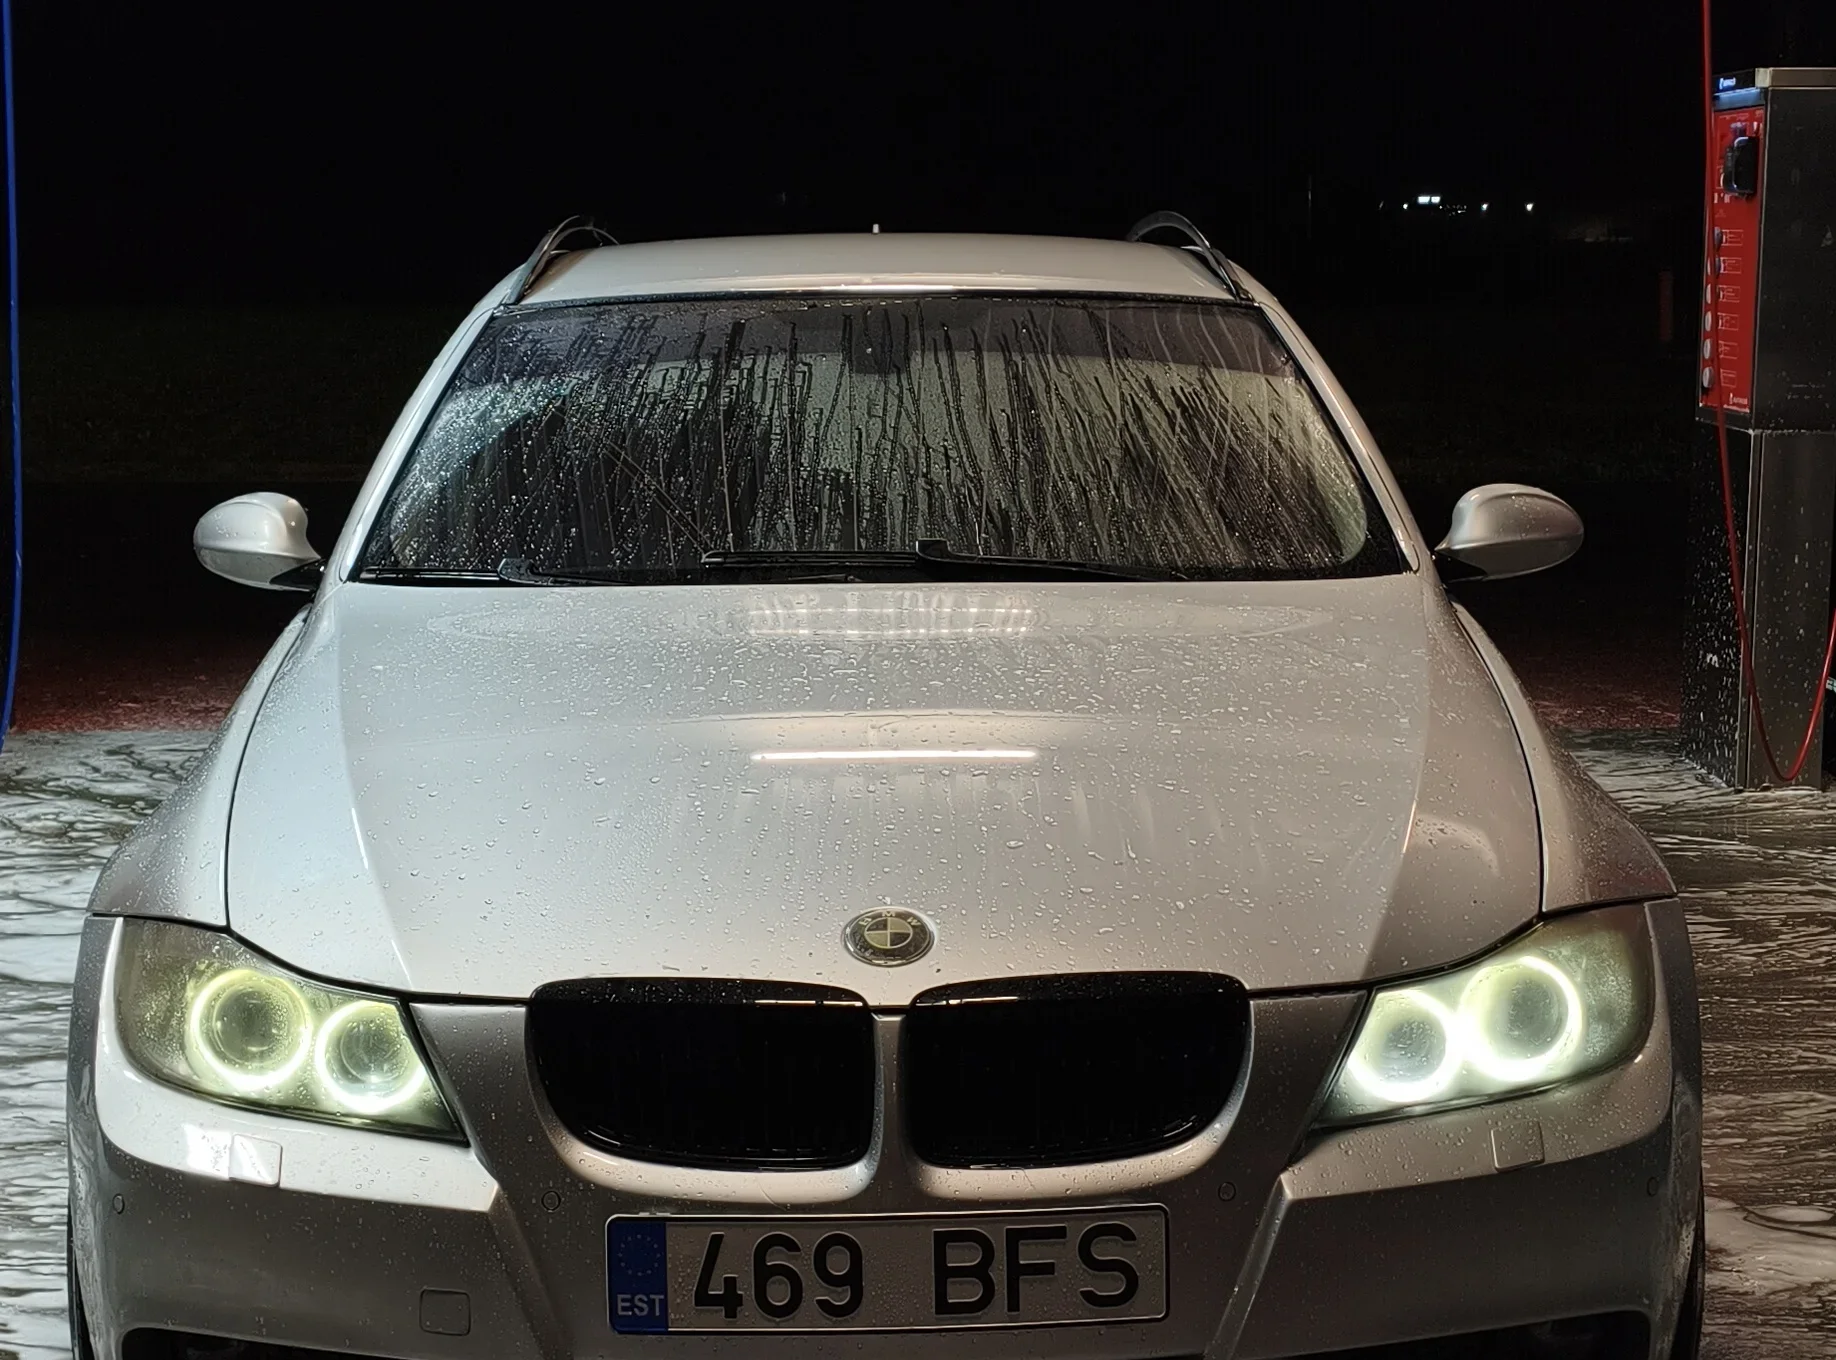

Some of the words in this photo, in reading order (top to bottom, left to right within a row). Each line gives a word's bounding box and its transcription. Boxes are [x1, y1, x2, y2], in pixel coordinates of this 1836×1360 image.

[693, 1232, 866, 1321] 469
[931, 1222, 1141, 1317] BFS
[617, 1294, 665, 1317] EST
